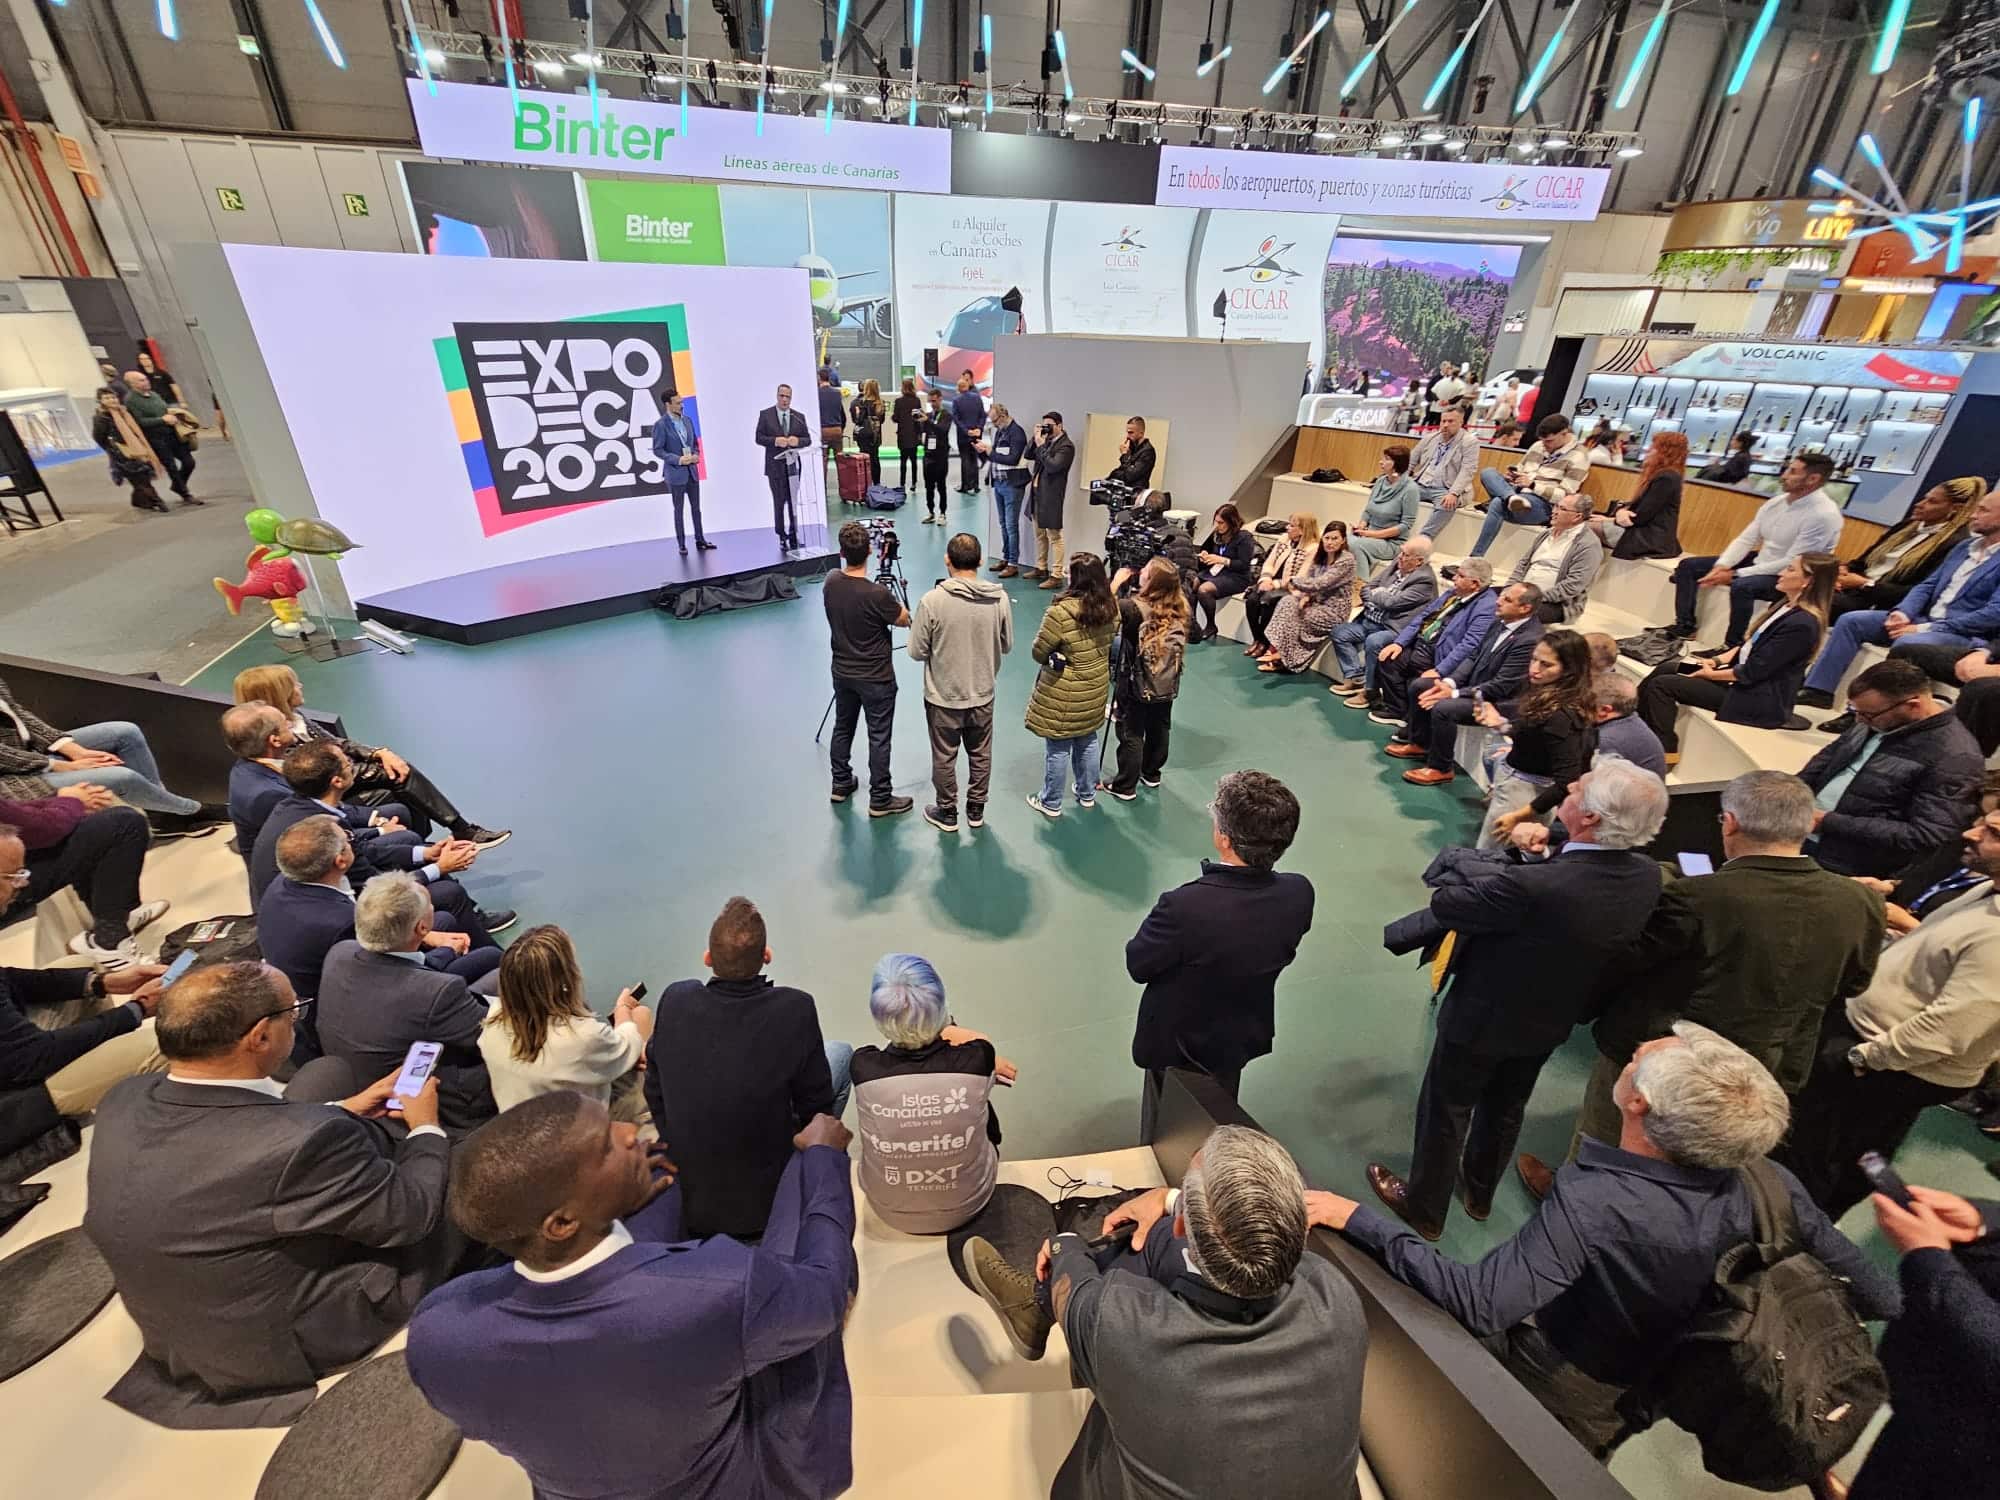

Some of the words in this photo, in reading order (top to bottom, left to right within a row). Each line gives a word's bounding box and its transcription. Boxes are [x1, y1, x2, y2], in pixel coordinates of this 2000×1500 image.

[514, 101, 675, 161] Binter
[822, 162, 839, 176] de
[843, 164, 900, 180] Canarias
[1168, 165, 1185, 188] En
[1188, 165, 1221, 190] todos
[1222, 166, 1239, 191] los
[1241, 174, 1316, 199] aeropuertos,
[1318, 177, 1369, 202] puertos
[1369, 183, 1379, 204] y
[1381, 183, 1416, 199] zonas
[1535, 175, 1584, 199] CICAR
[626, 214, 693, 238] Binter
[962, 215, 1007, 234] Alquiler
[940, 240, 998, 259] Canarias
[982, 232, 1023, 248] Coches
[1105, 254, 1139, 268] CICAR
[1231, 287, 1288, 310] CICAR
[1742, 347, 1828, 361] VOLCANIC
[472, 338, 662, 397] EXPO
[486, 388, 664, 450] DECA
[503, 437, 665, 500] 2025
[871, 1103, 941, 1119] Canarias
[902, 1093, 941, 1107] Islas
[905, 1163, 963, 1185] DXT
